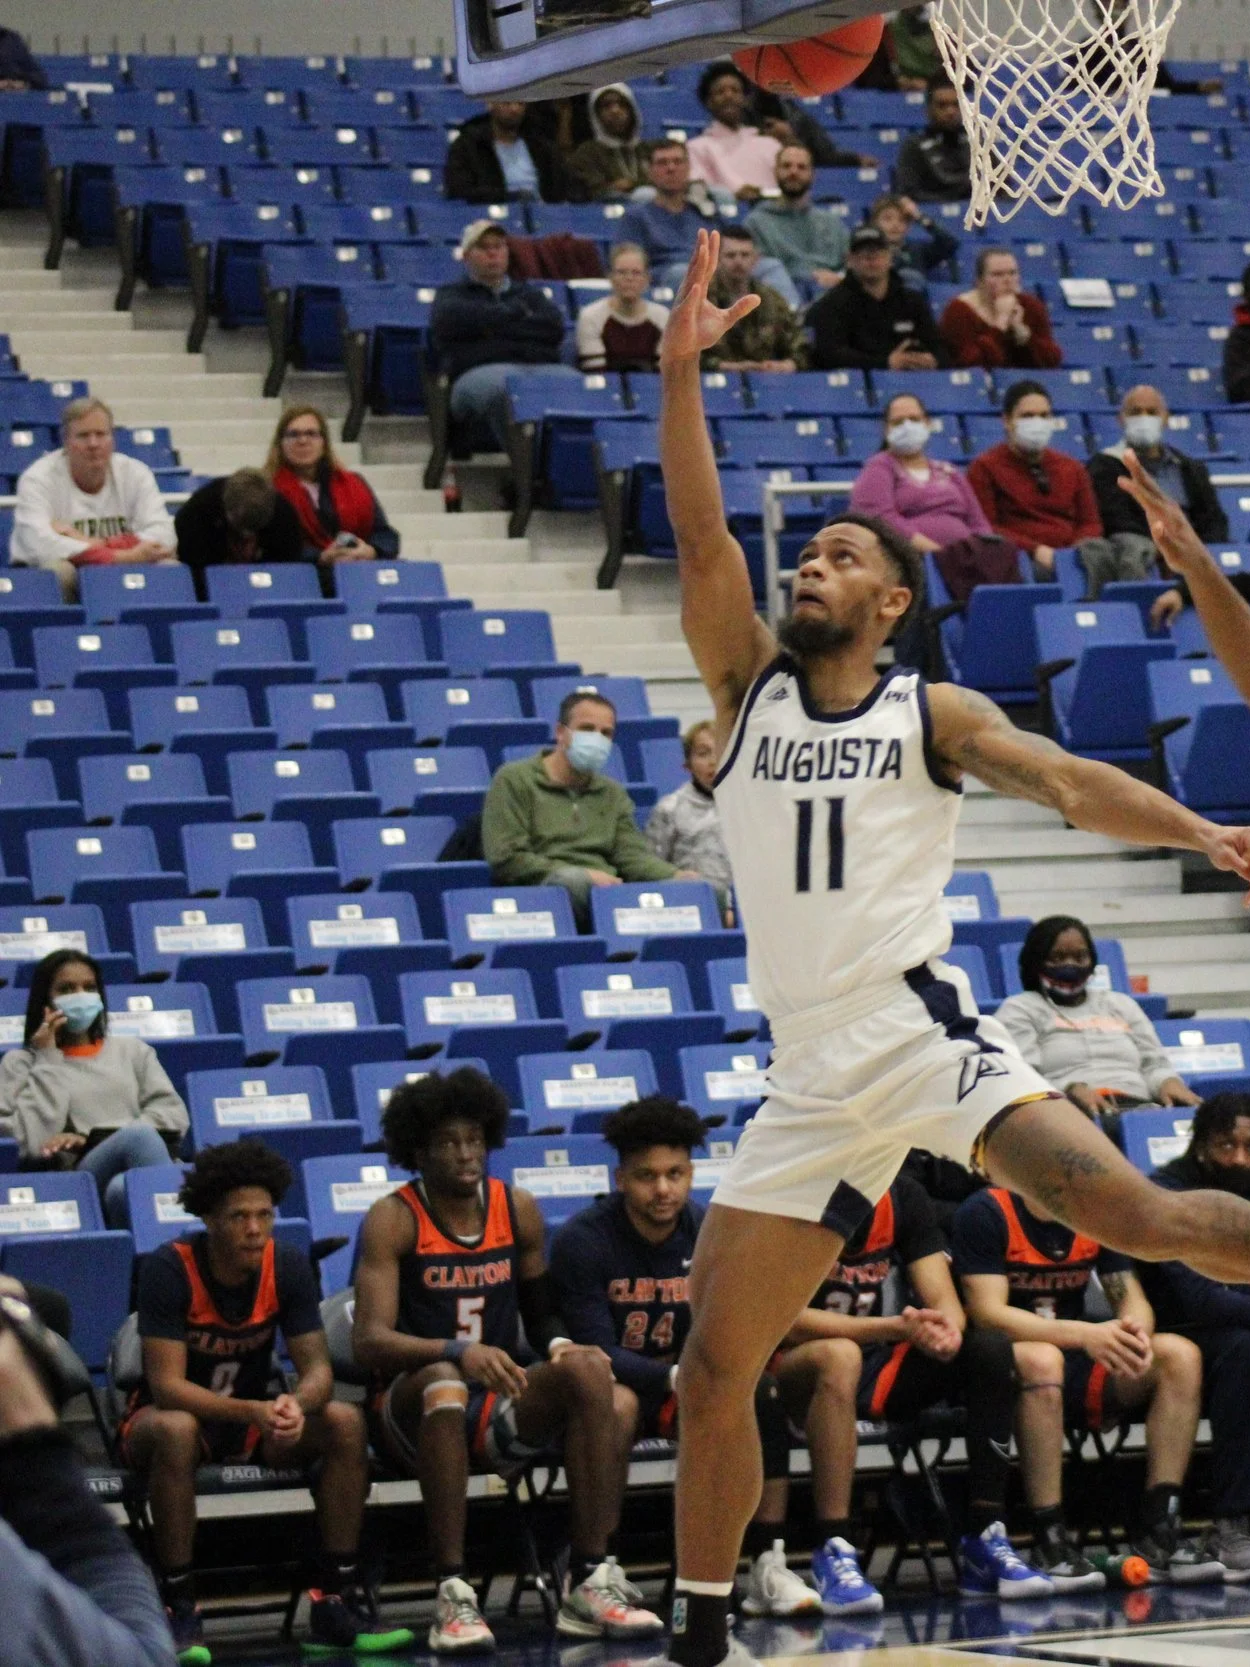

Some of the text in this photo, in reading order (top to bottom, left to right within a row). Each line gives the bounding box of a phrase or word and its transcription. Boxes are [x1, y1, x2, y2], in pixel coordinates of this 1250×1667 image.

[752, 735, 903, 783] AUGUSTA
[792, 796, 847, 894] 11
[423, 1258, 512, 1289] CLAYTON
[607, 1276, 693, 1304] CLAYTO
[456, 1296, 485, 1342] 5
[621, 1310, 676, 1349] 24
